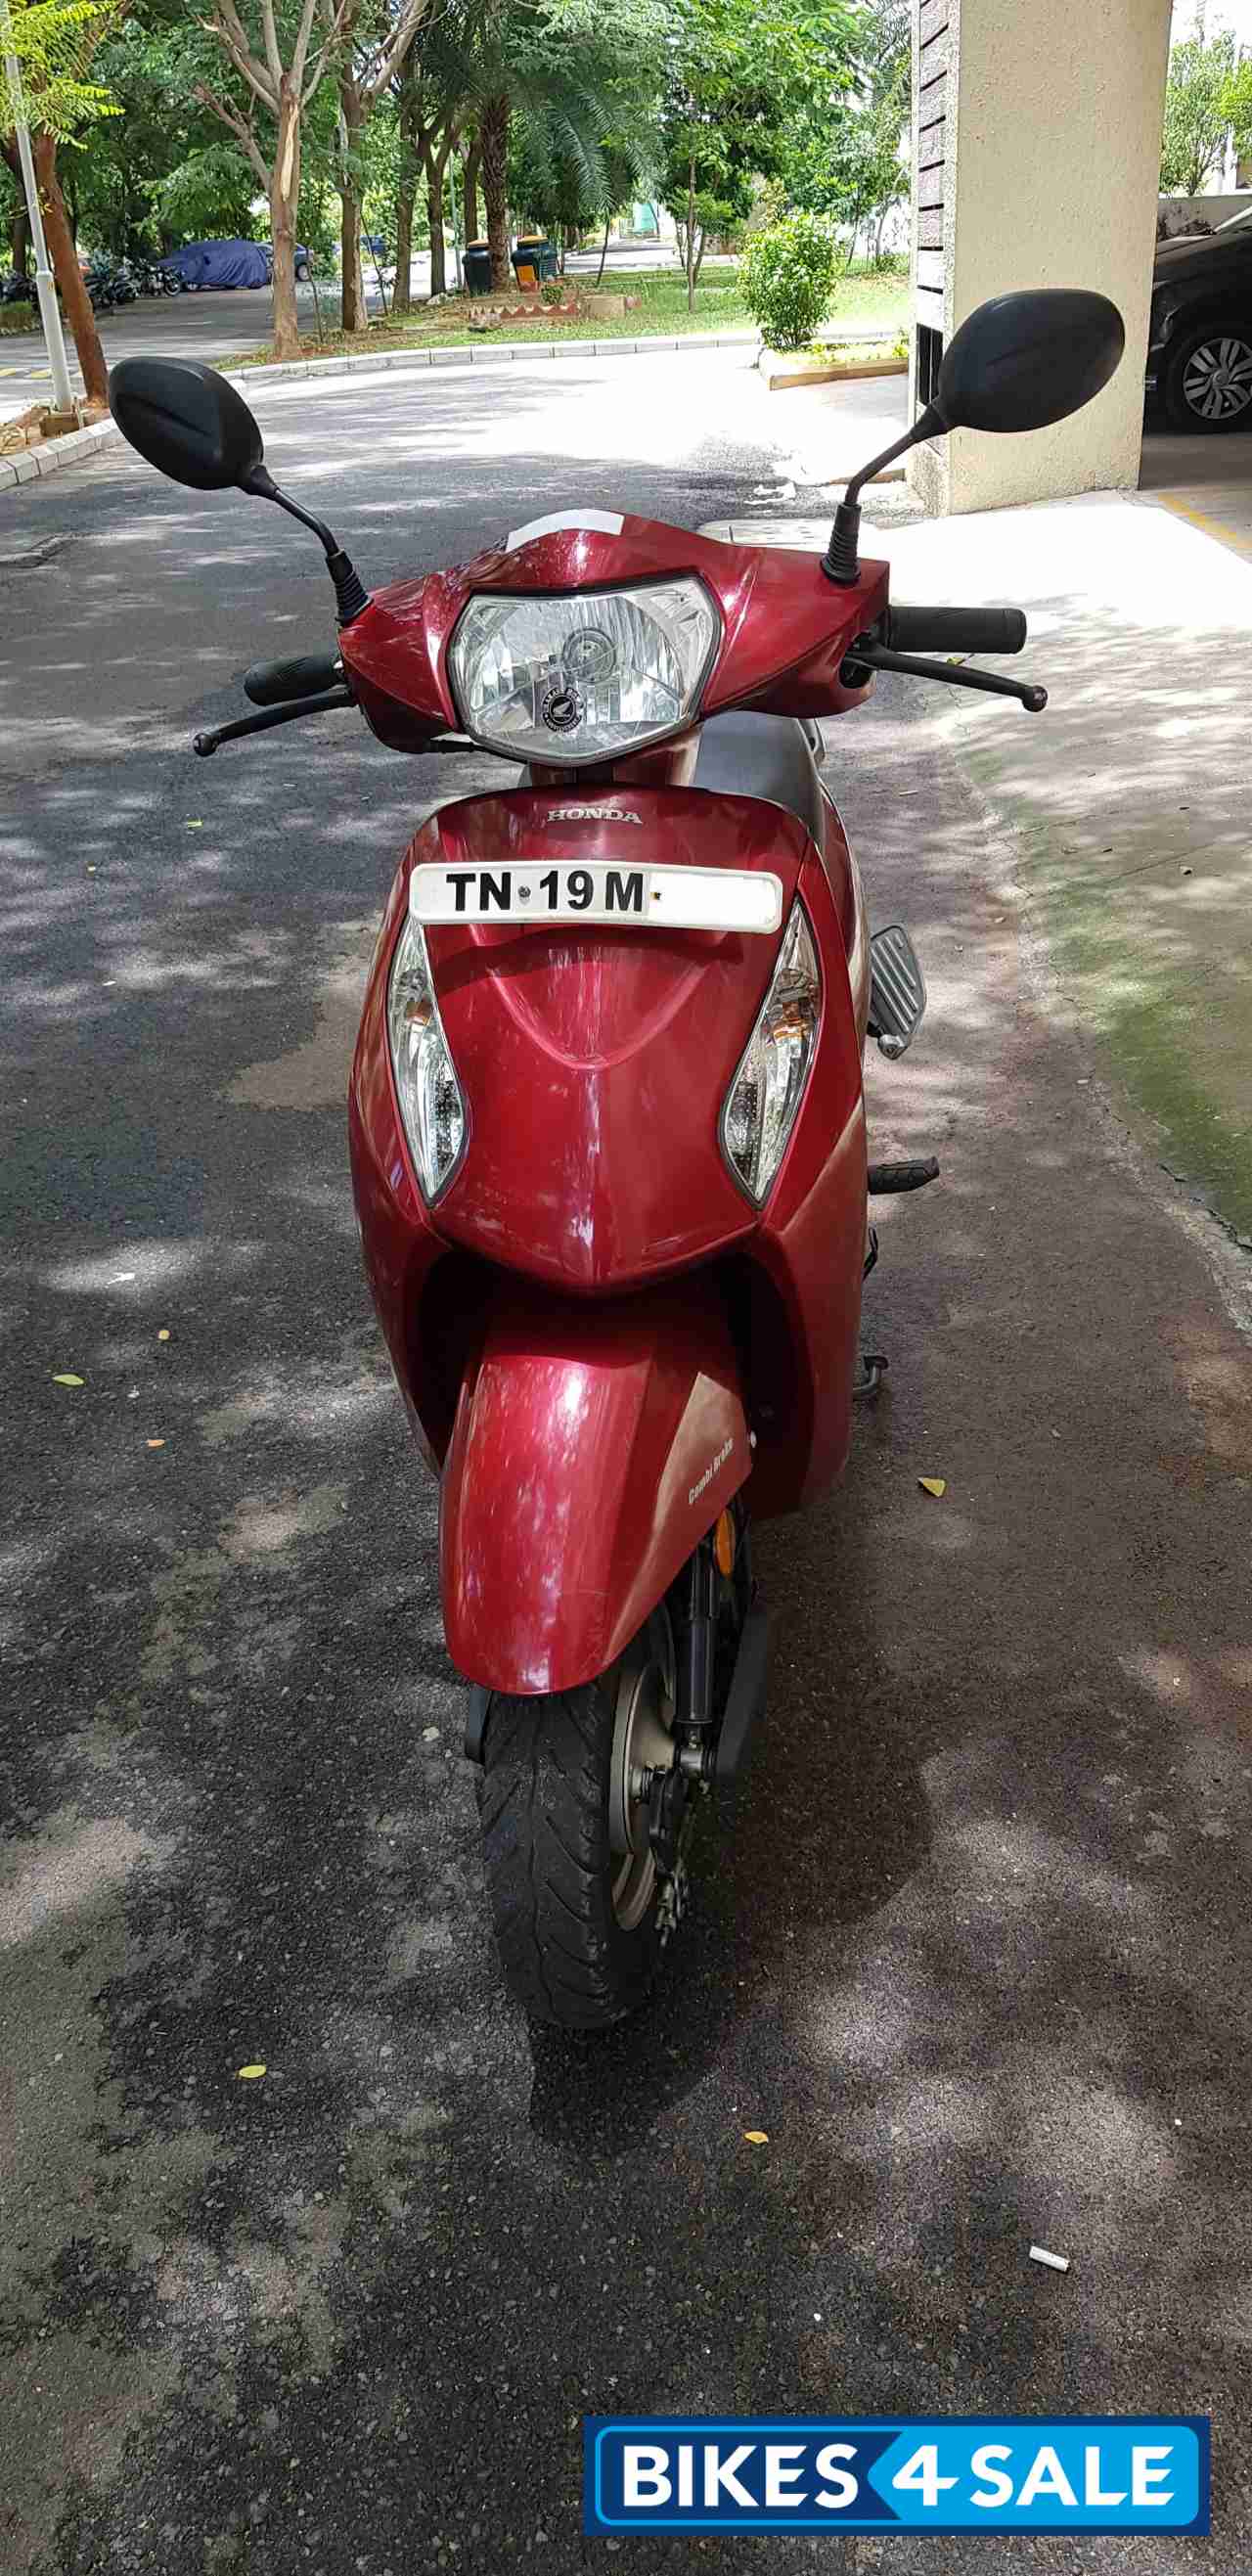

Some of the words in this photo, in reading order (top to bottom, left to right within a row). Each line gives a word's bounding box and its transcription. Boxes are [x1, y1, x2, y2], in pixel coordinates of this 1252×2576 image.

[547, 807, 643, 824] HONDA
[446, 872, 512, 912] TN
[539, 870, 594, 911] 19
[604, 872, 644, 912] M
